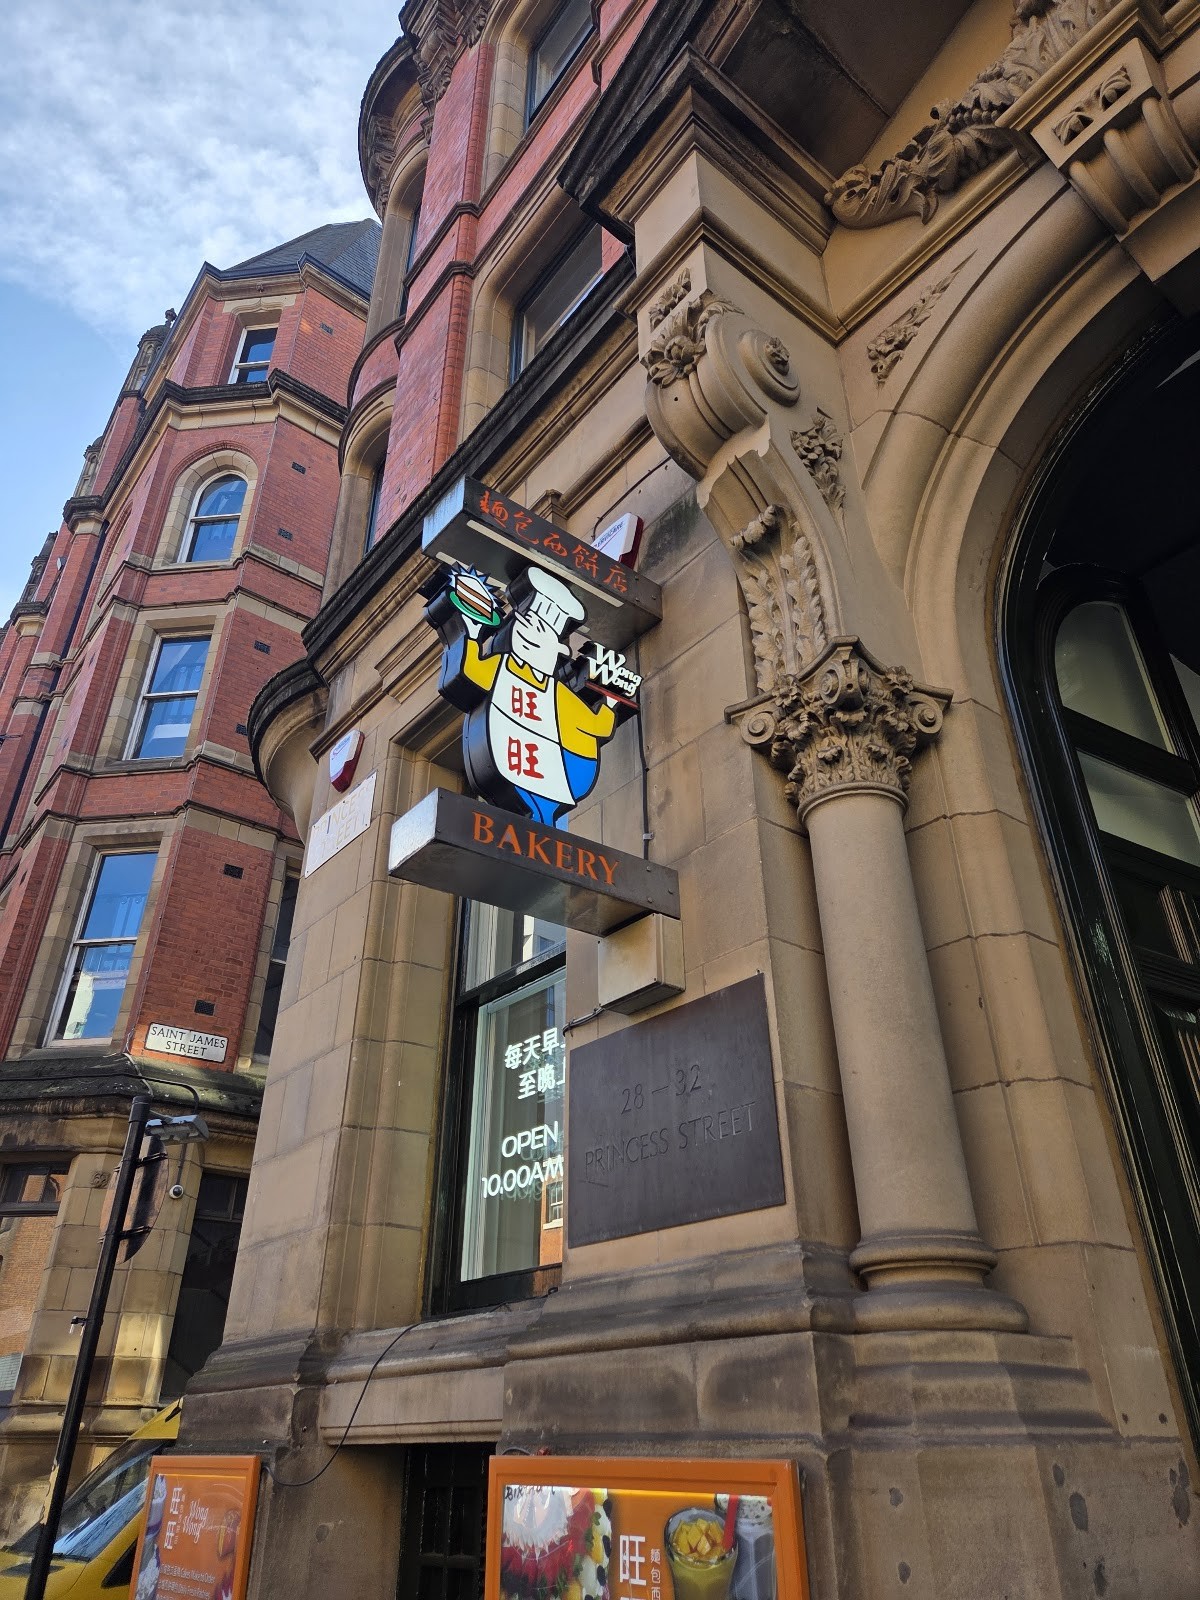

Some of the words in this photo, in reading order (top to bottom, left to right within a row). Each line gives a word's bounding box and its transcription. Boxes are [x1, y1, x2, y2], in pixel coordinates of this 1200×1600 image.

[586, 656, 637, 697] Wong
[594, 642, 642, 687] Wong
[472, 811, 620, 885] BAKERY
[150, 1026, 186, 1041] SAINT
[189, 1033, 226, 1049] JAMES
[165, 1040, 207, 1057] STREET
[505, 1027, 565, 1070] 每天早
[621, 1083, 645, 1115] 28
[675, 1064, 702, 1097] 32
[501, 1120, 559, 1158] OPEN
[585, 1127, 669, 1181] PRINCESS
[678, 1101, 757, 1150] STREET
[481, 1154, 564, 1199] 10.00AM
[183, 1515, 202, 1544] Wong
[190, 1498, 209, 1528] Wong
[619, 1534, 647, 1600] 旺
